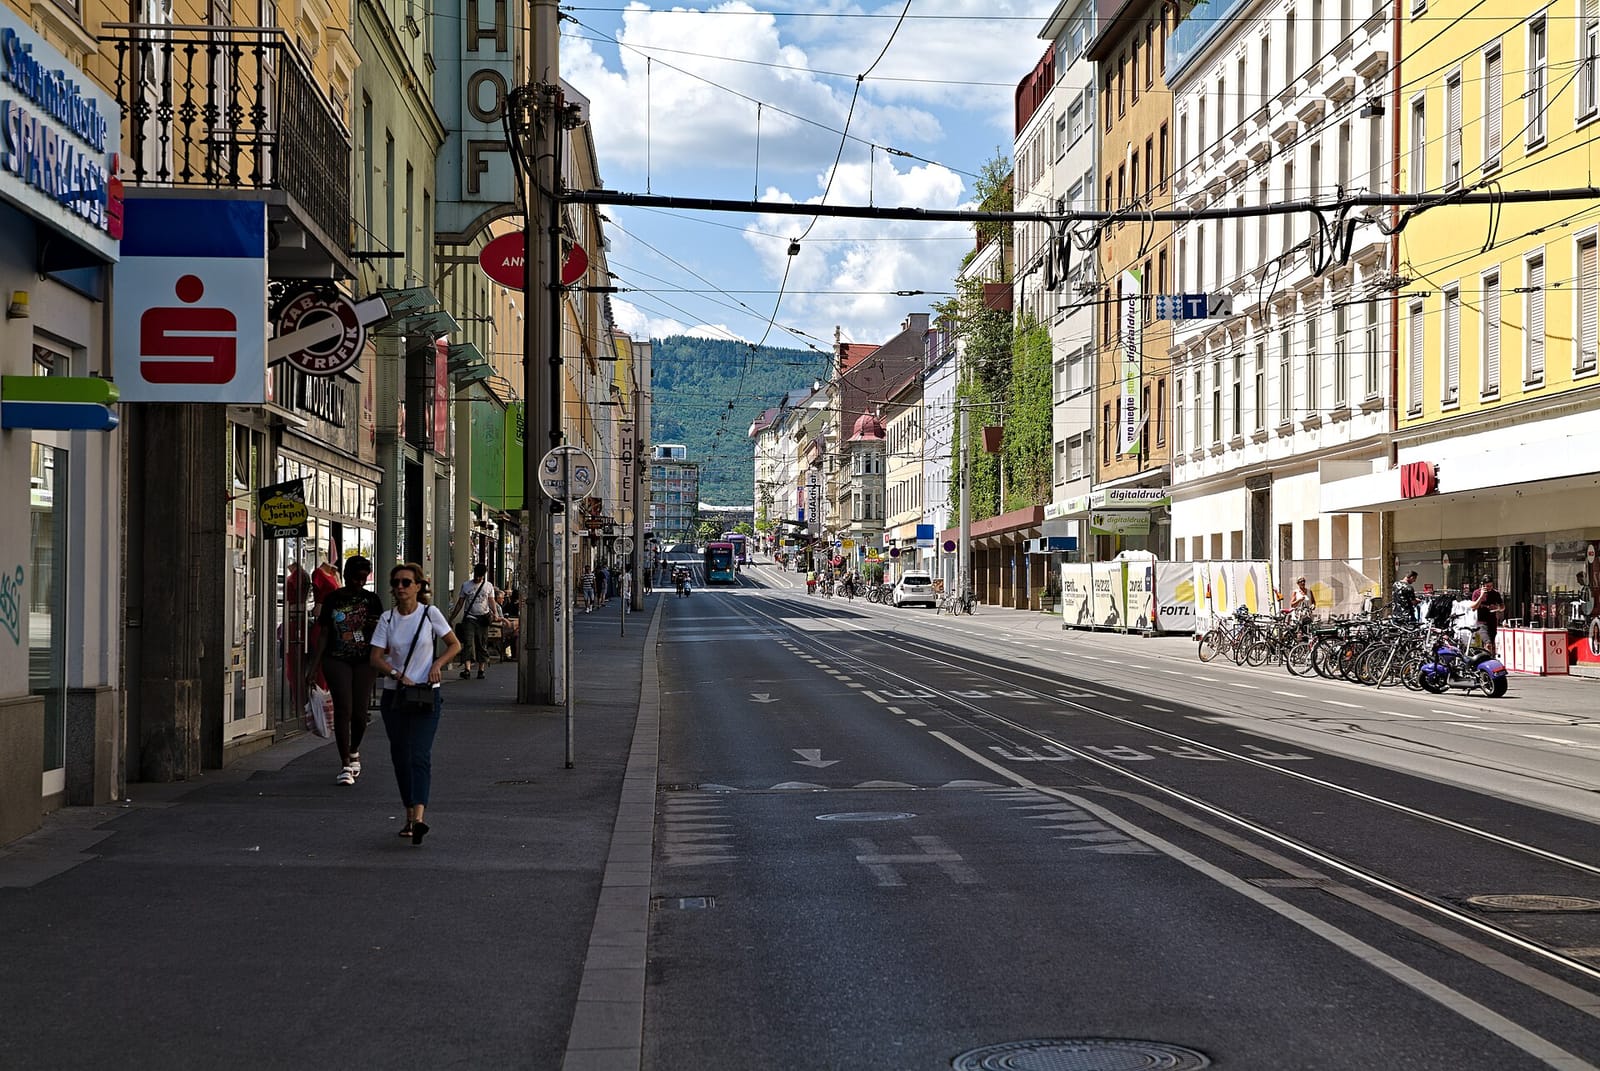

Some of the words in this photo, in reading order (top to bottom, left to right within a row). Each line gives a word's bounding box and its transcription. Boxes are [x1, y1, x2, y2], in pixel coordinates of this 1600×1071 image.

[2, 99, 109, 231] SPARKASSE
[301, 326, 357, 369] TRAFIK
[622, 437, 632, 502] HOTEL
[1401, 461, 1434, 498] NKD
[1110, 489, 1166, 500] digitaldruck
[268, 509, 305, 520] Jackpot
[1160, 606, 1190, 616] FOITL
